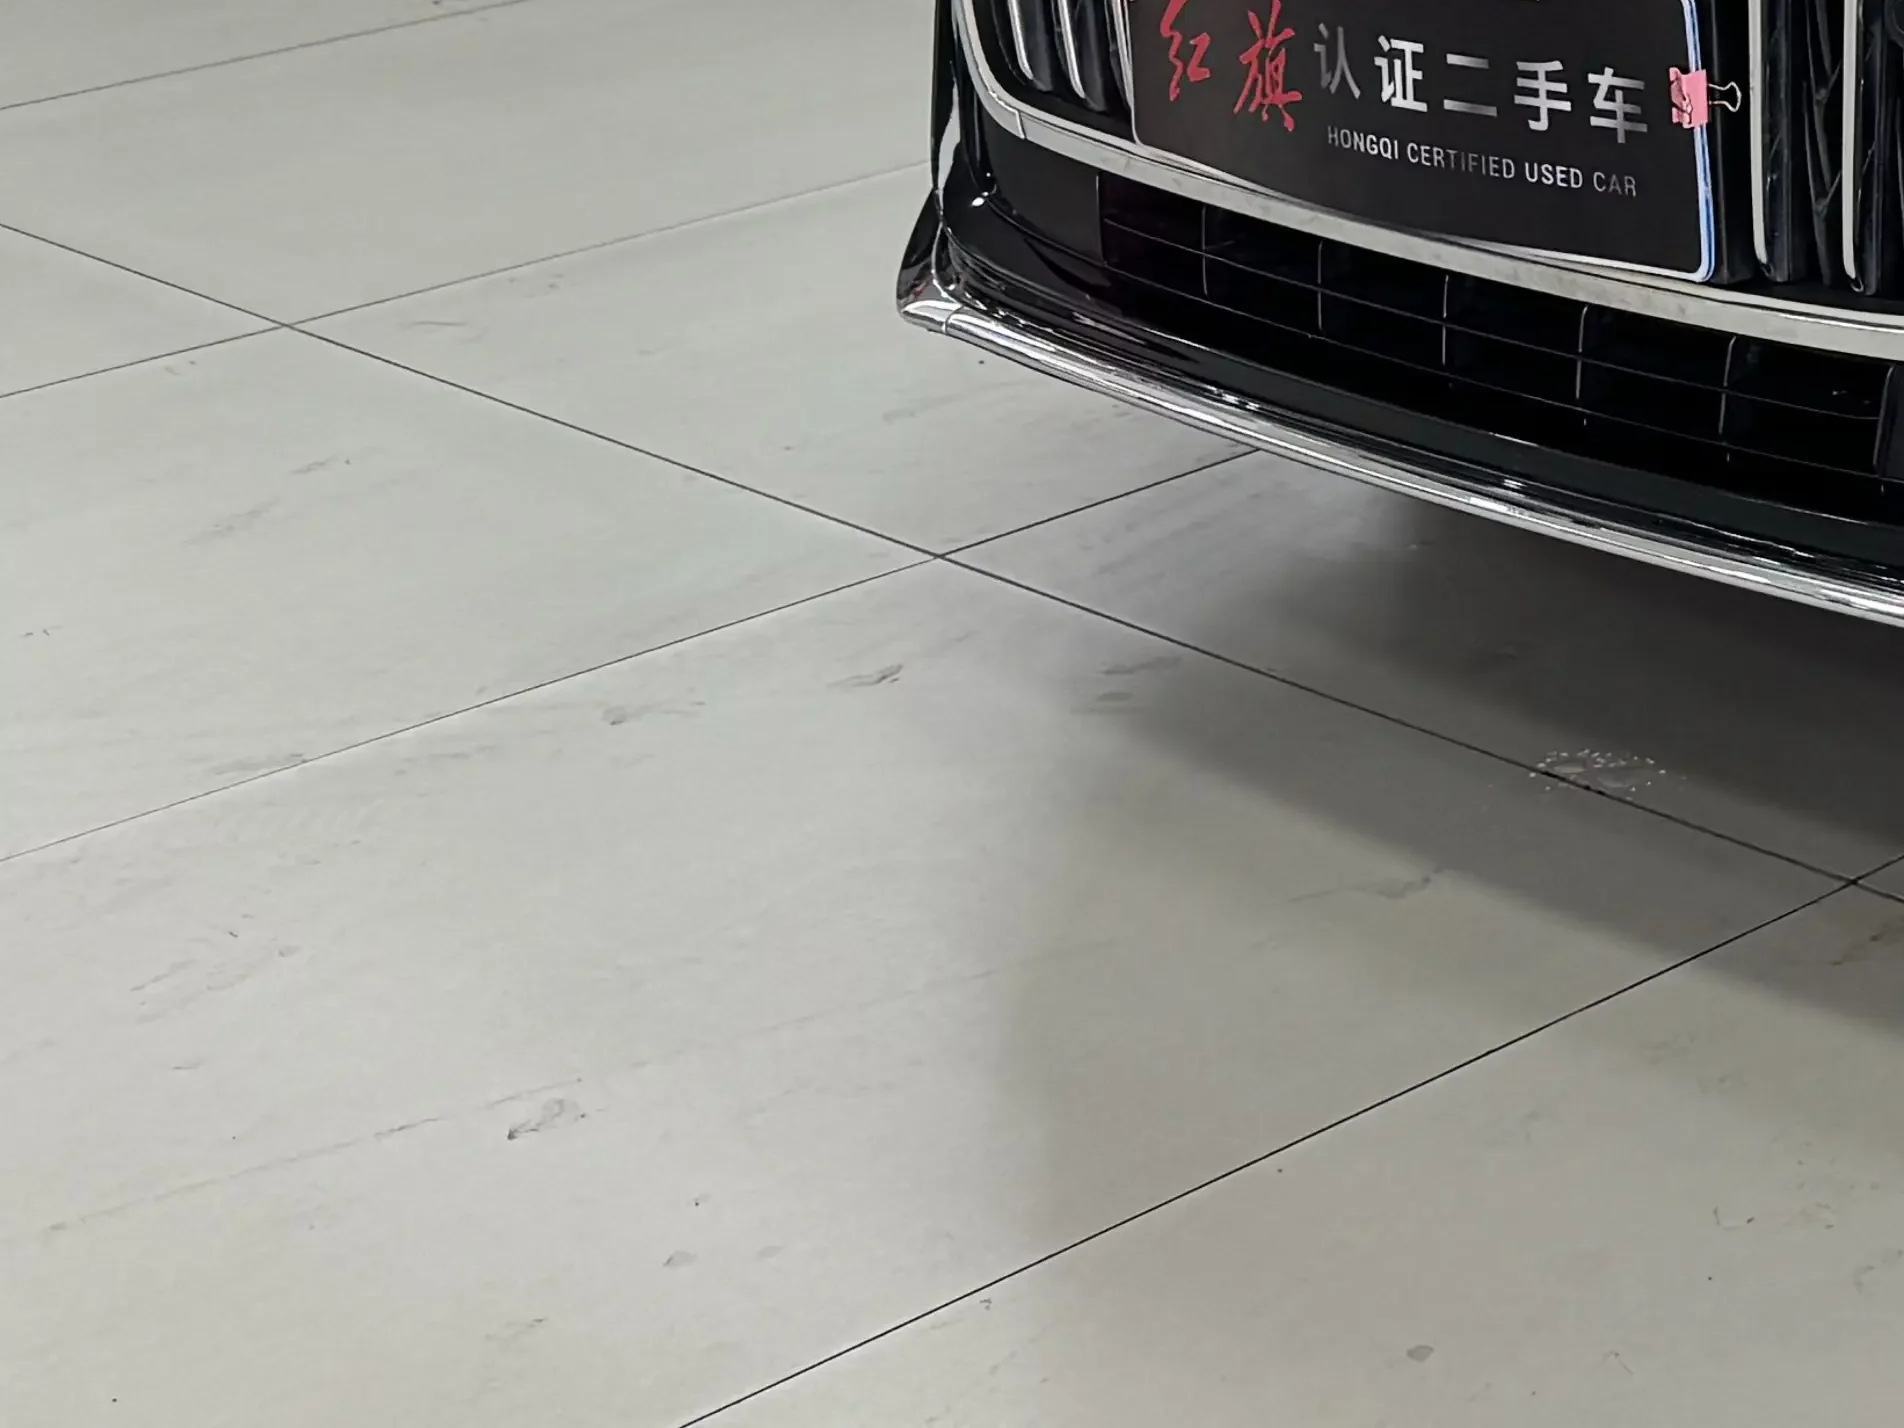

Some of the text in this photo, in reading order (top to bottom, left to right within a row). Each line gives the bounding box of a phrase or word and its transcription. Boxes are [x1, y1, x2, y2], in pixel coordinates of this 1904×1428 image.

[1328, 124, 1637, 197] HONGQI CERTIFIED USED CAR
